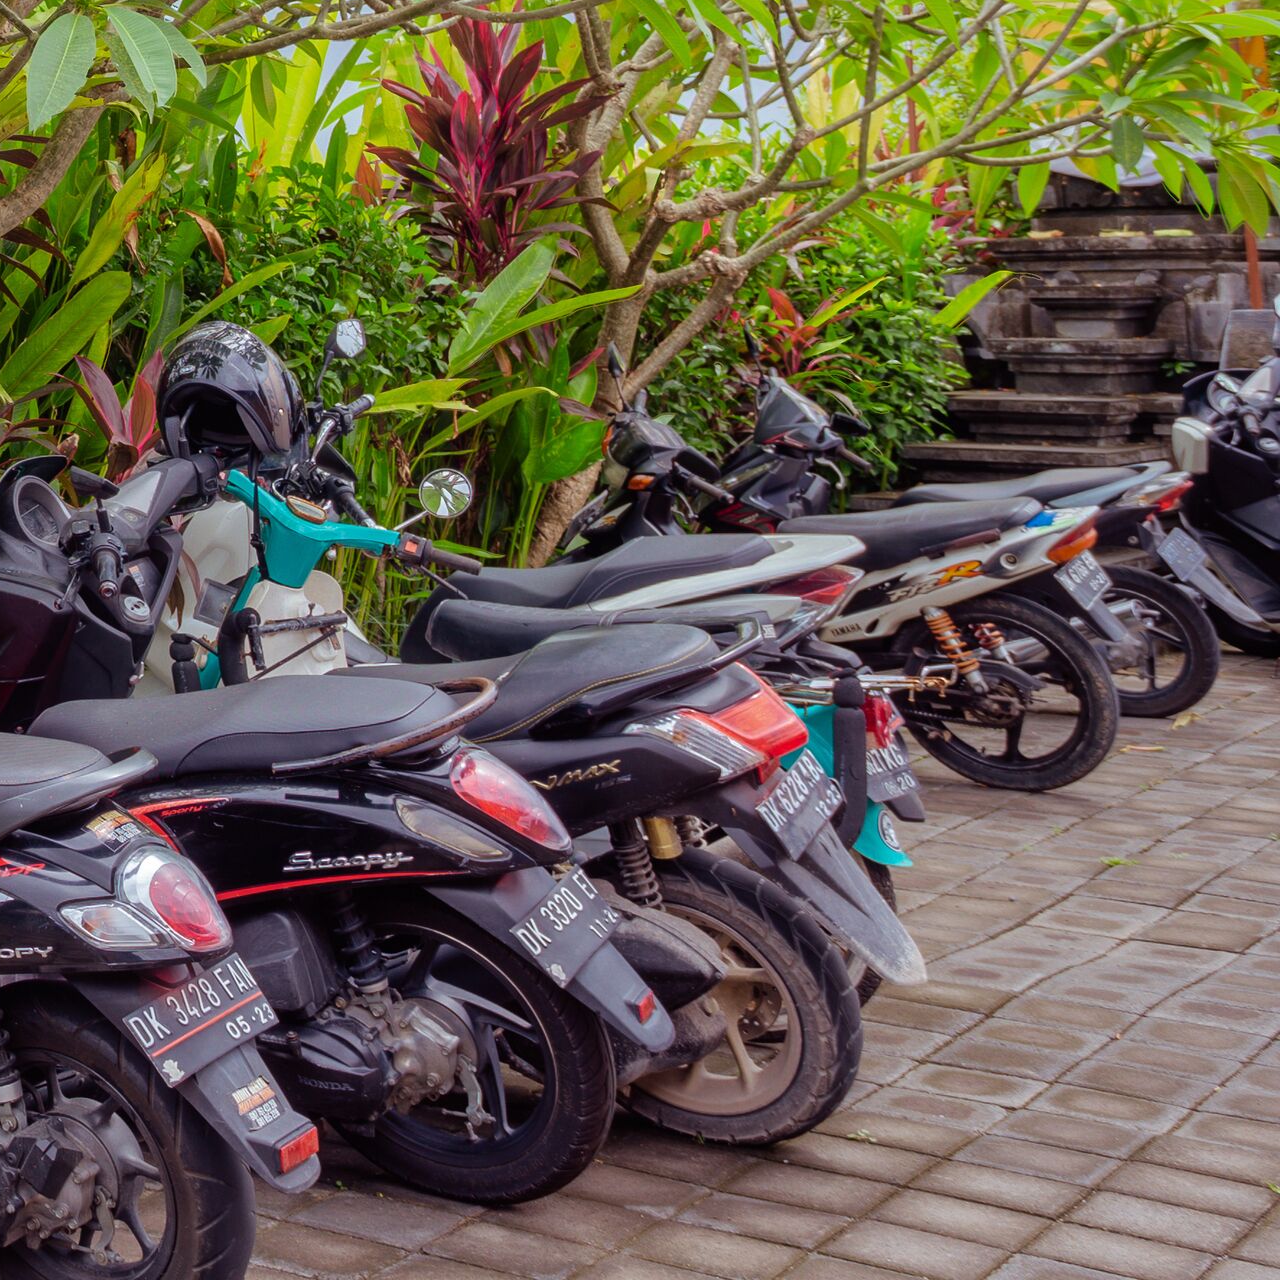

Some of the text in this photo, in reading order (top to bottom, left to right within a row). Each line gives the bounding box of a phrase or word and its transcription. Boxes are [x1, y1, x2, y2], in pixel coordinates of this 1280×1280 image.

[830, 622, 862, 637] YAMAHA
[760, 797, 787, 832] DK
[776, 770, 809, 814] 6228
[283, 851, 415, 871] Scoopy
[517, 918, 552, 955] DK
[540, 887, 583, 931] 3320
[128, 958, 257, 1048] DK 3428 FAN
[298, 1075, 355, 1091] HONDA
